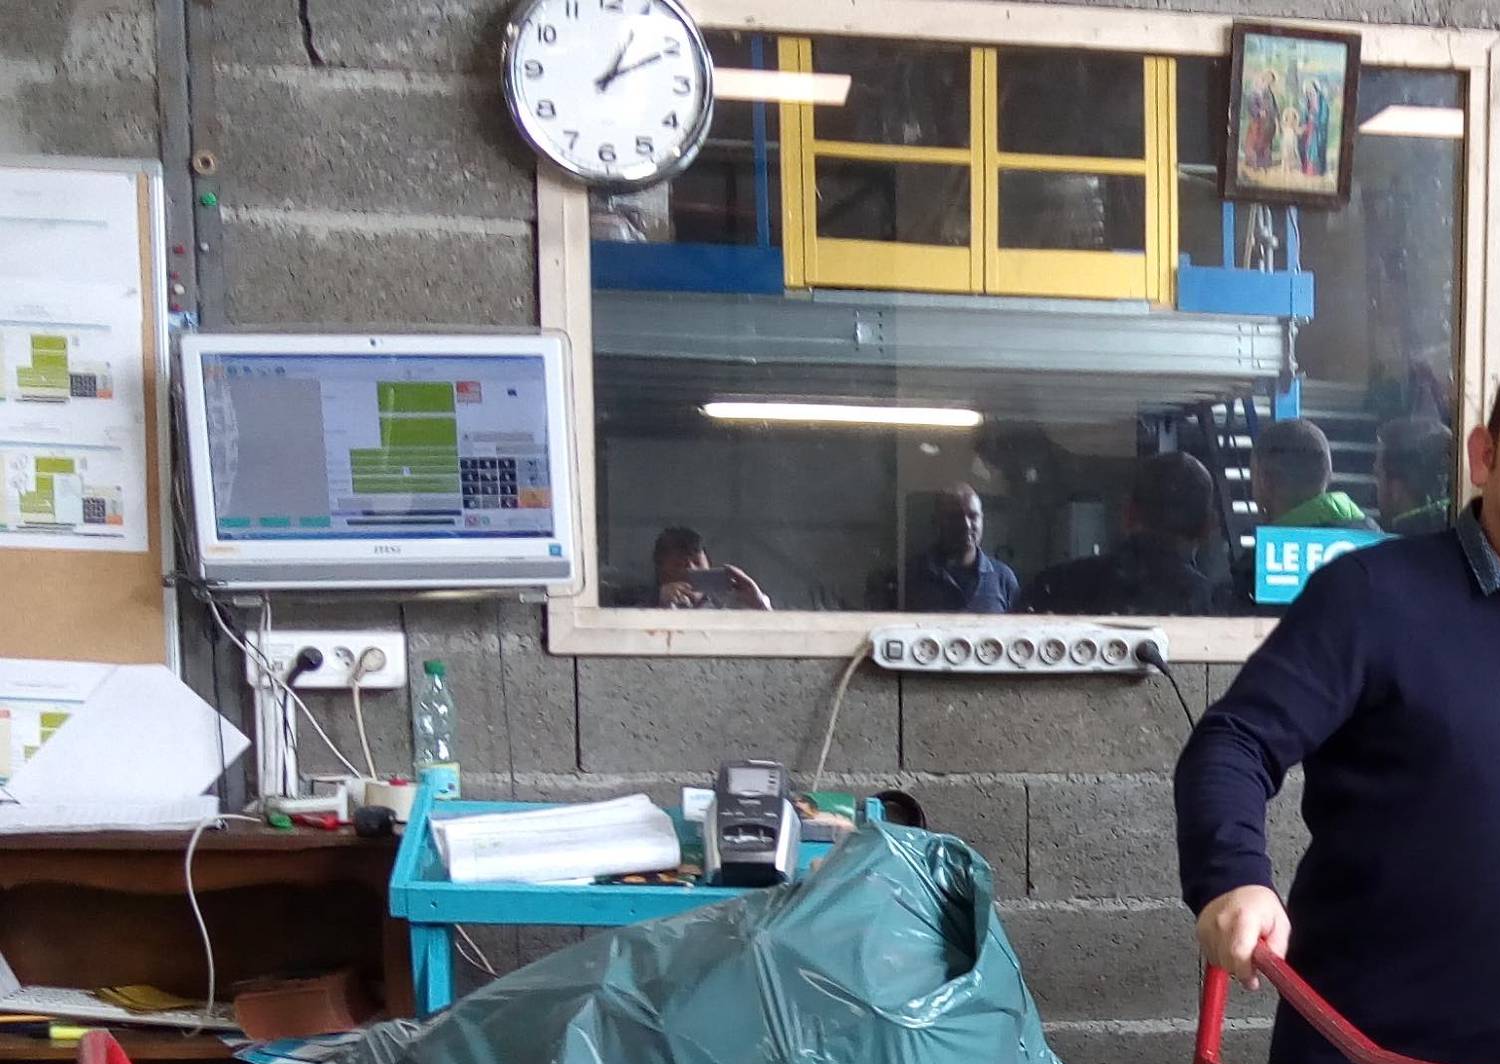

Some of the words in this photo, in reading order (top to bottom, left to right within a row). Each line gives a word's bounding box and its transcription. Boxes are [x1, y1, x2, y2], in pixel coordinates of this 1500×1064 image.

[565, 0, 579, 19] 11
[537, 23, 557, 44] 10
[663, 37, 681, 57] 2
[524, 59, 544, 79] 9
[672, 75, 691, 96] 3
[536, 100, 557, 120] 8
[661, 111, 679, 130] 4
[563, 130, 580, 151] 7
[634, 136, 655, 156] 5
[598, 143, 617, 163] 6
[1266, 542, 1300, 571] LE
